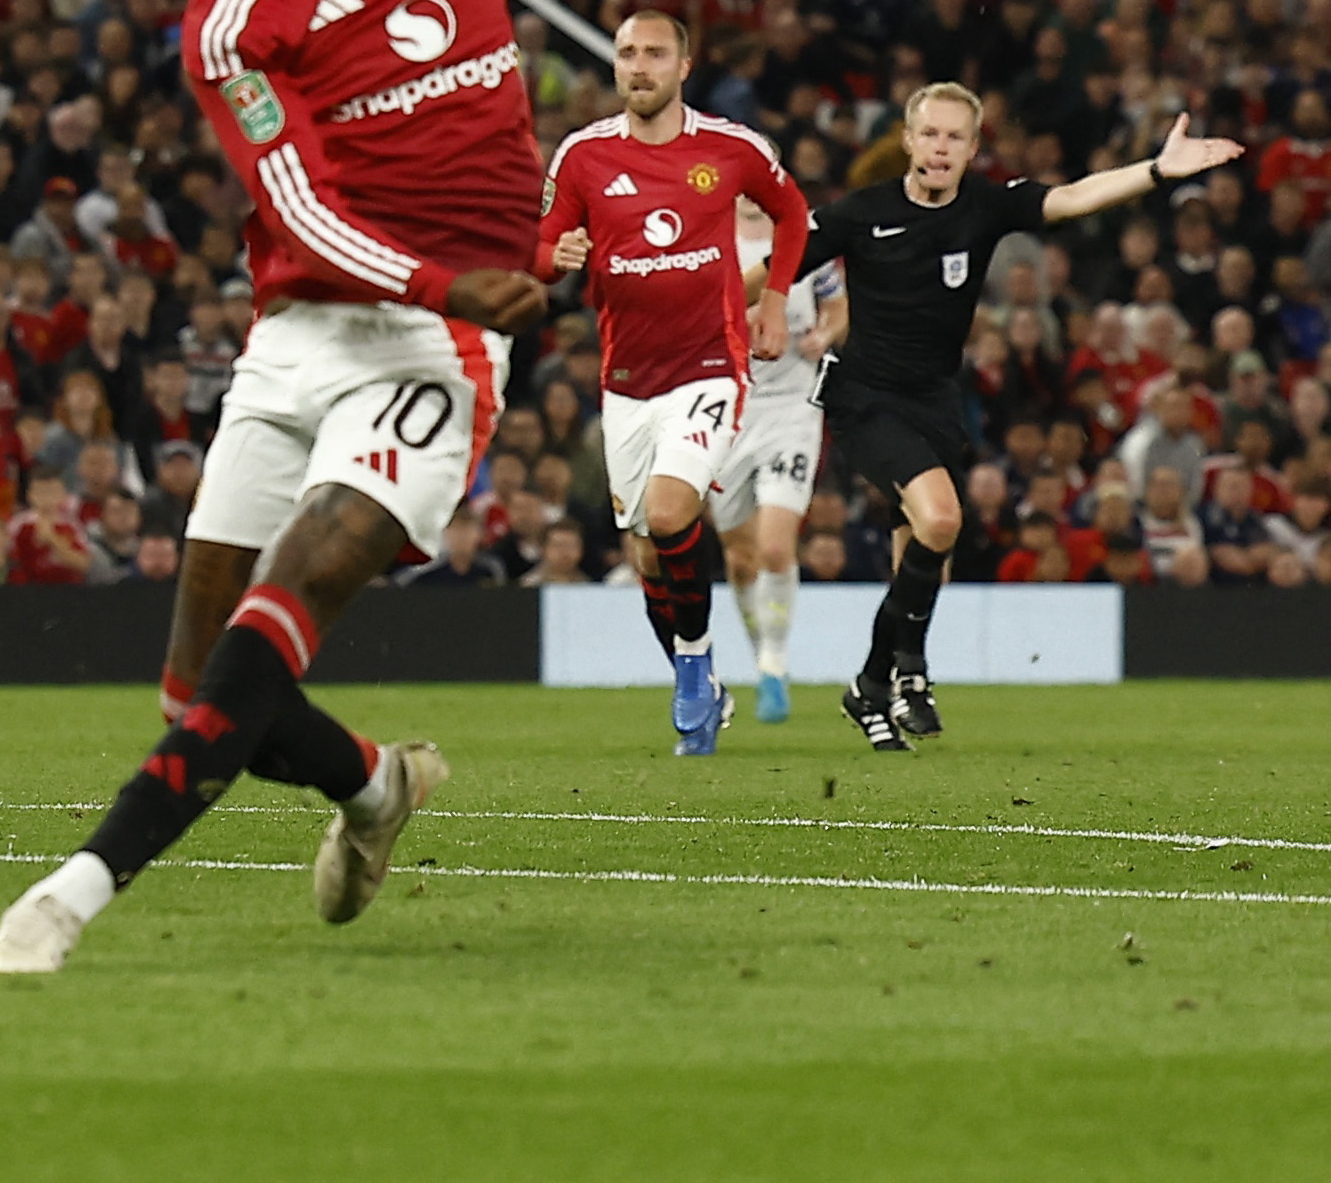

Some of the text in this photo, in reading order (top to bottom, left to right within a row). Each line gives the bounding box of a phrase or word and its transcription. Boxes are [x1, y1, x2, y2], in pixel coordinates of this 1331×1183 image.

[609, 246, 722, 277] Snapdragon
[372, 380, 453, 449] 10
[687, 392, 728, 433] 14
[770, 452, 808, 483] 48
